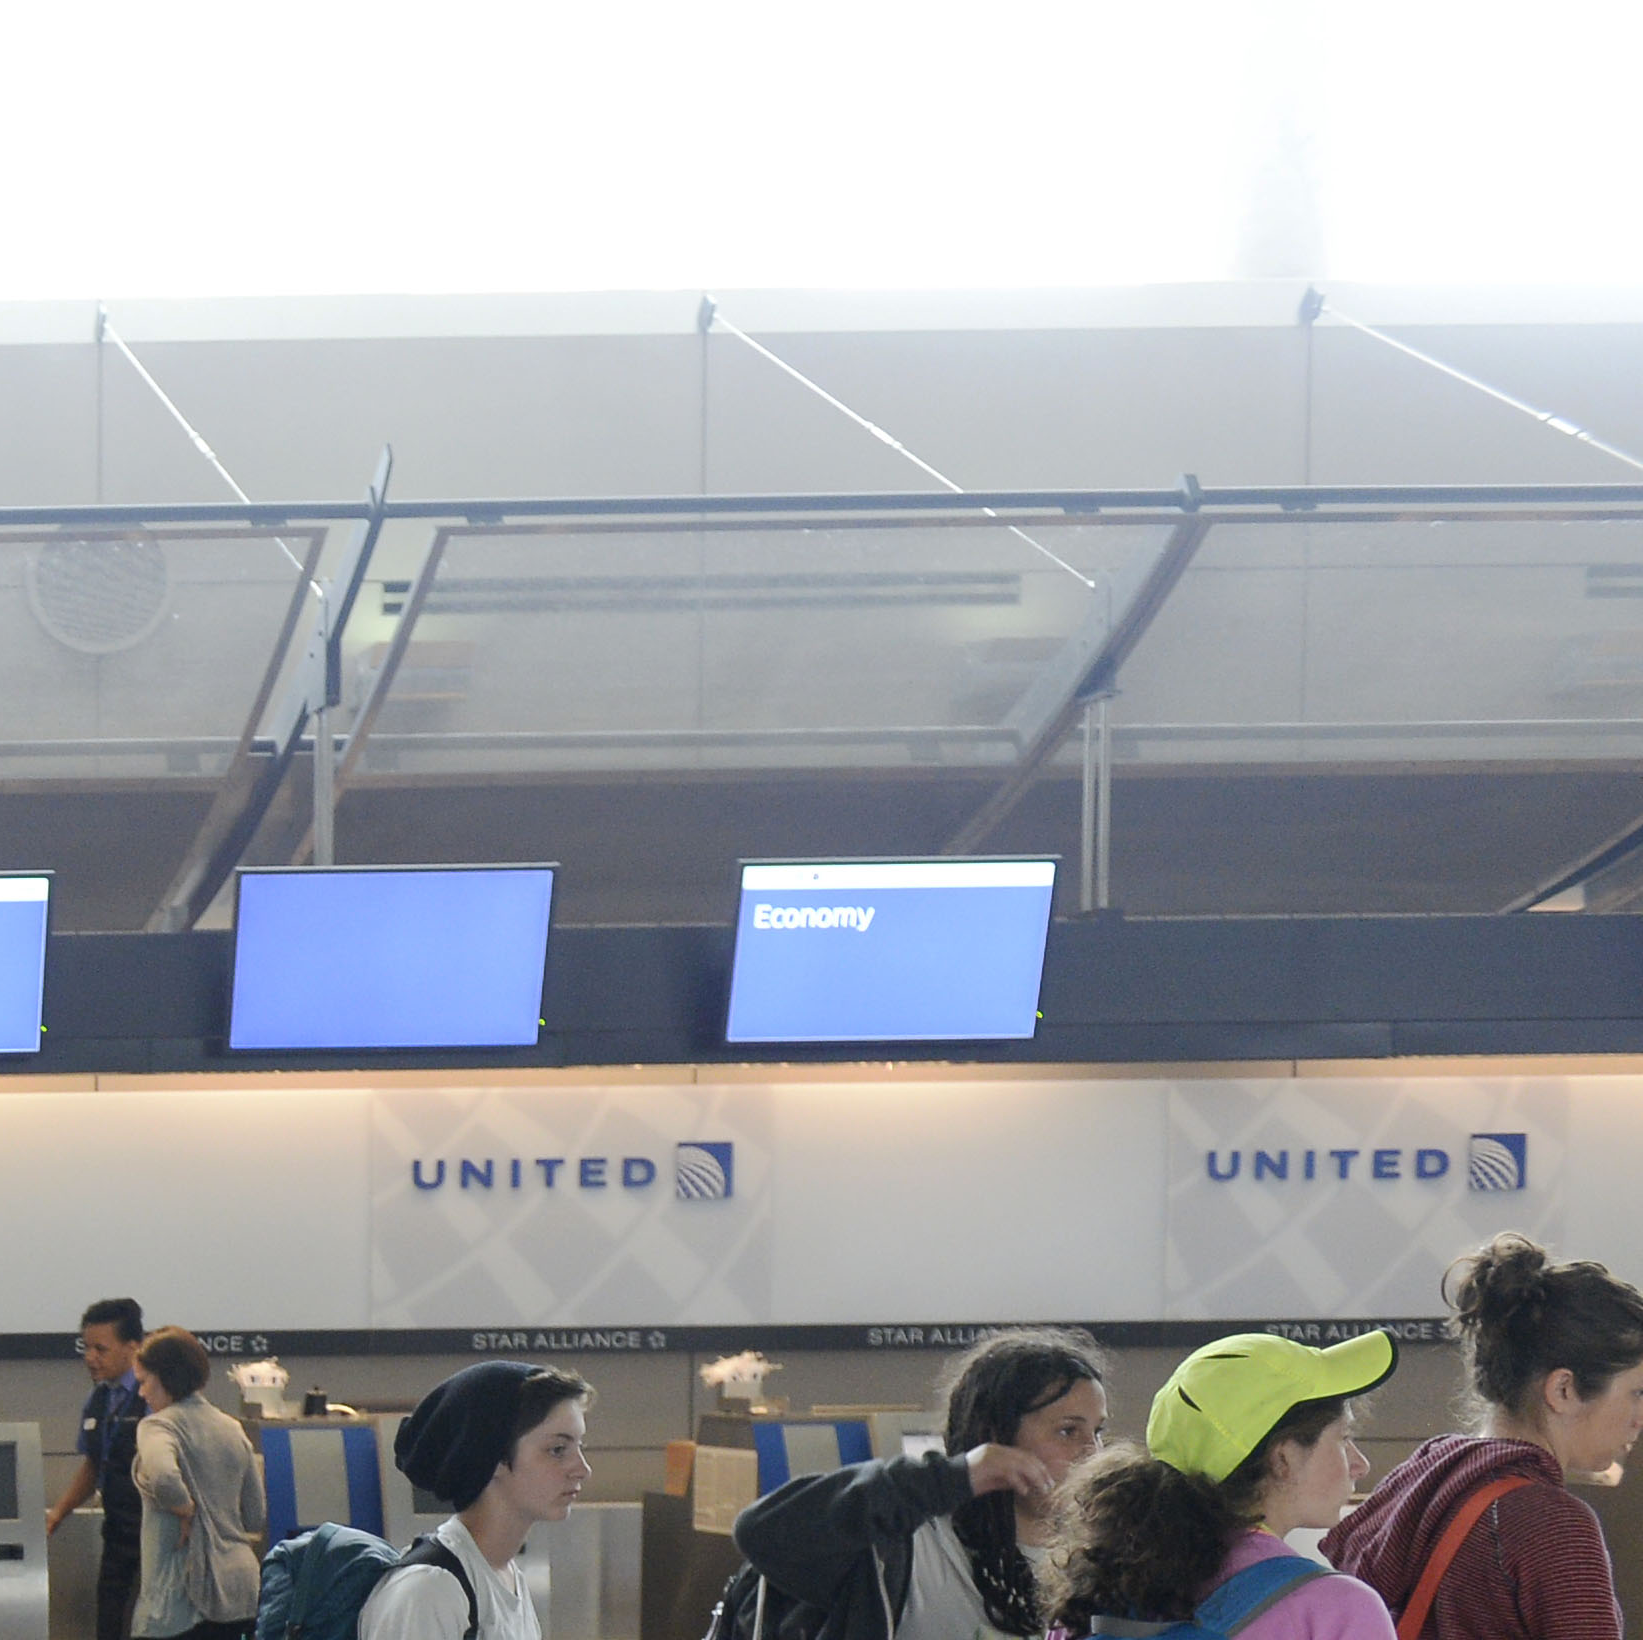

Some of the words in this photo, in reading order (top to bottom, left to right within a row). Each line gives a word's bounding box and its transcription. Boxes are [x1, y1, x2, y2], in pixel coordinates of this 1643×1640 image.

[753, 903, 876, 932] Economy
[411, 1156, 658, 1191] UNITED
[1206, 1148, 1450, 1183] UNITED
[472, 1332, 529, 1350] STAR
[533, 1330, 642, 1349] ALLIANCE
[868, 1327, 925, 1346] STAR
[1266, 1323, 1321, 1340] STAR
